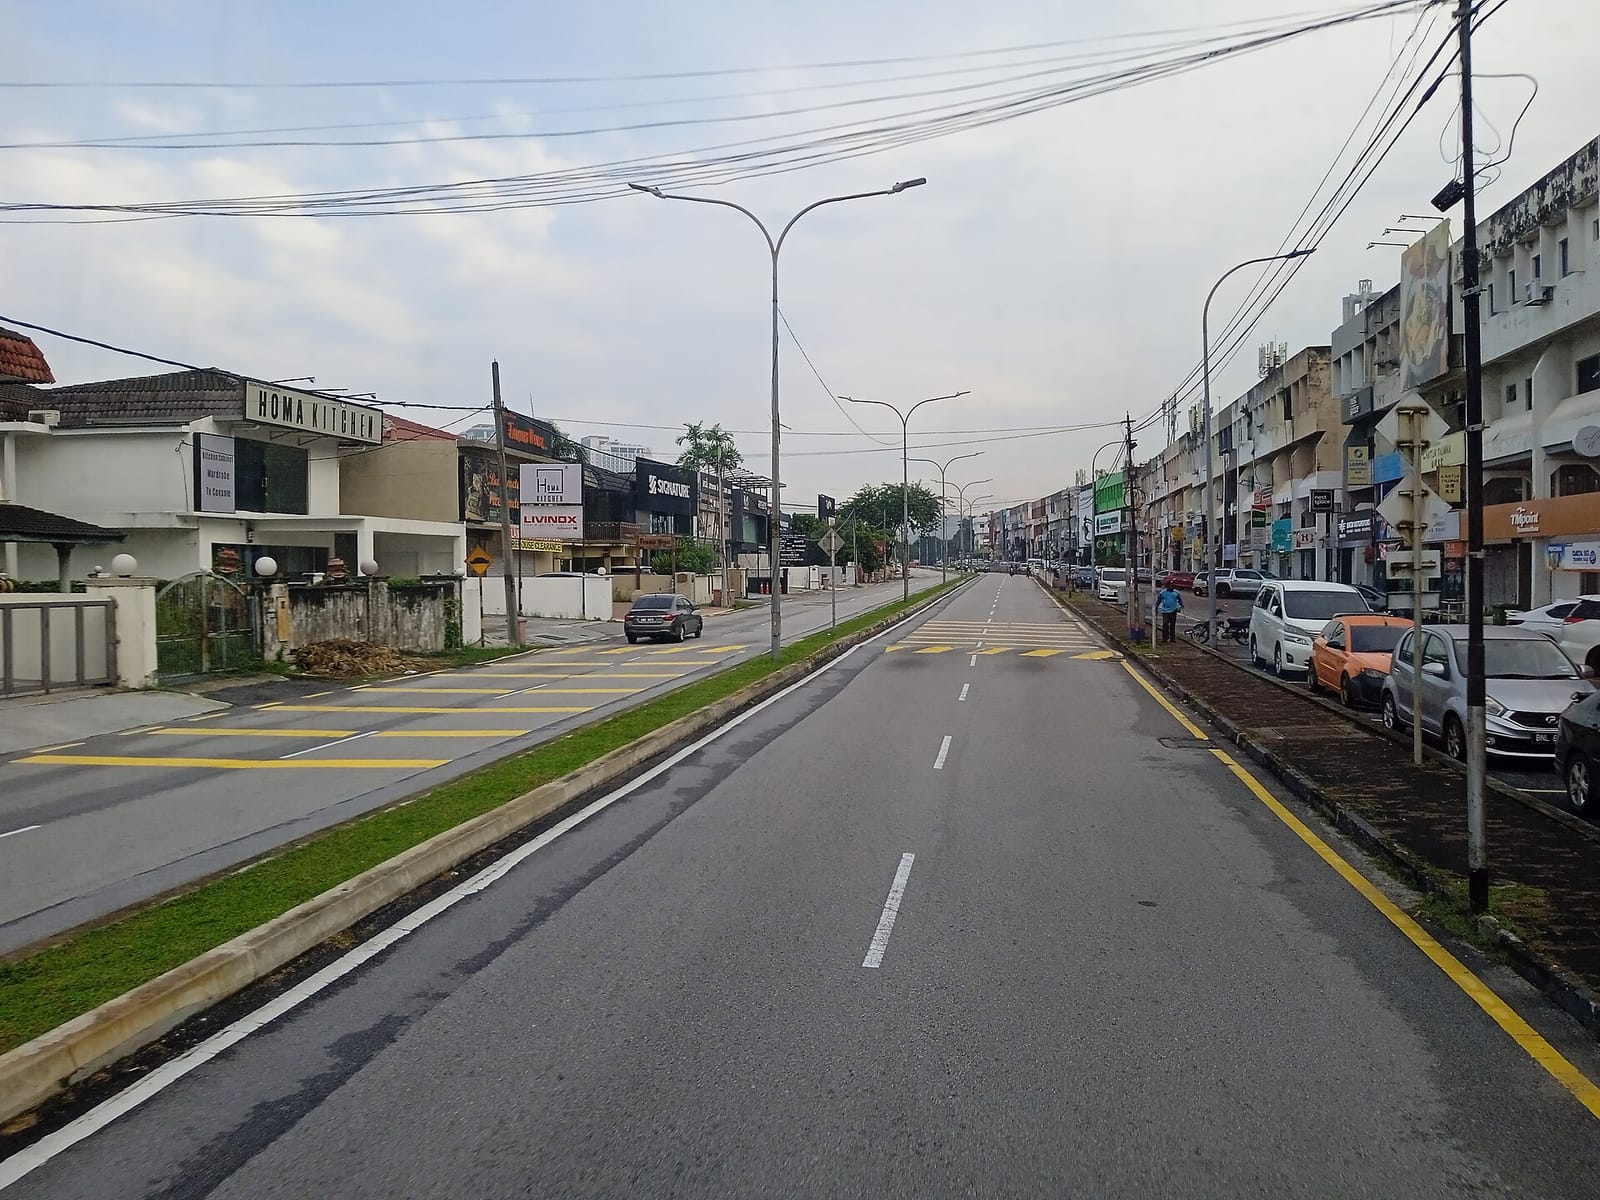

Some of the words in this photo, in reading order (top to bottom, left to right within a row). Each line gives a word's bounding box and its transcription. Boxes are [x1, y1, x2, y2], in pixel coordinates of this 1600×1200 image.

[259, 390, 303, 425] HOMA
[312, 402, 373, 439] KITCHEN
[657, 479, 690, 498] SIGNATURE
[1535, 733, 1550, 741] BNL
